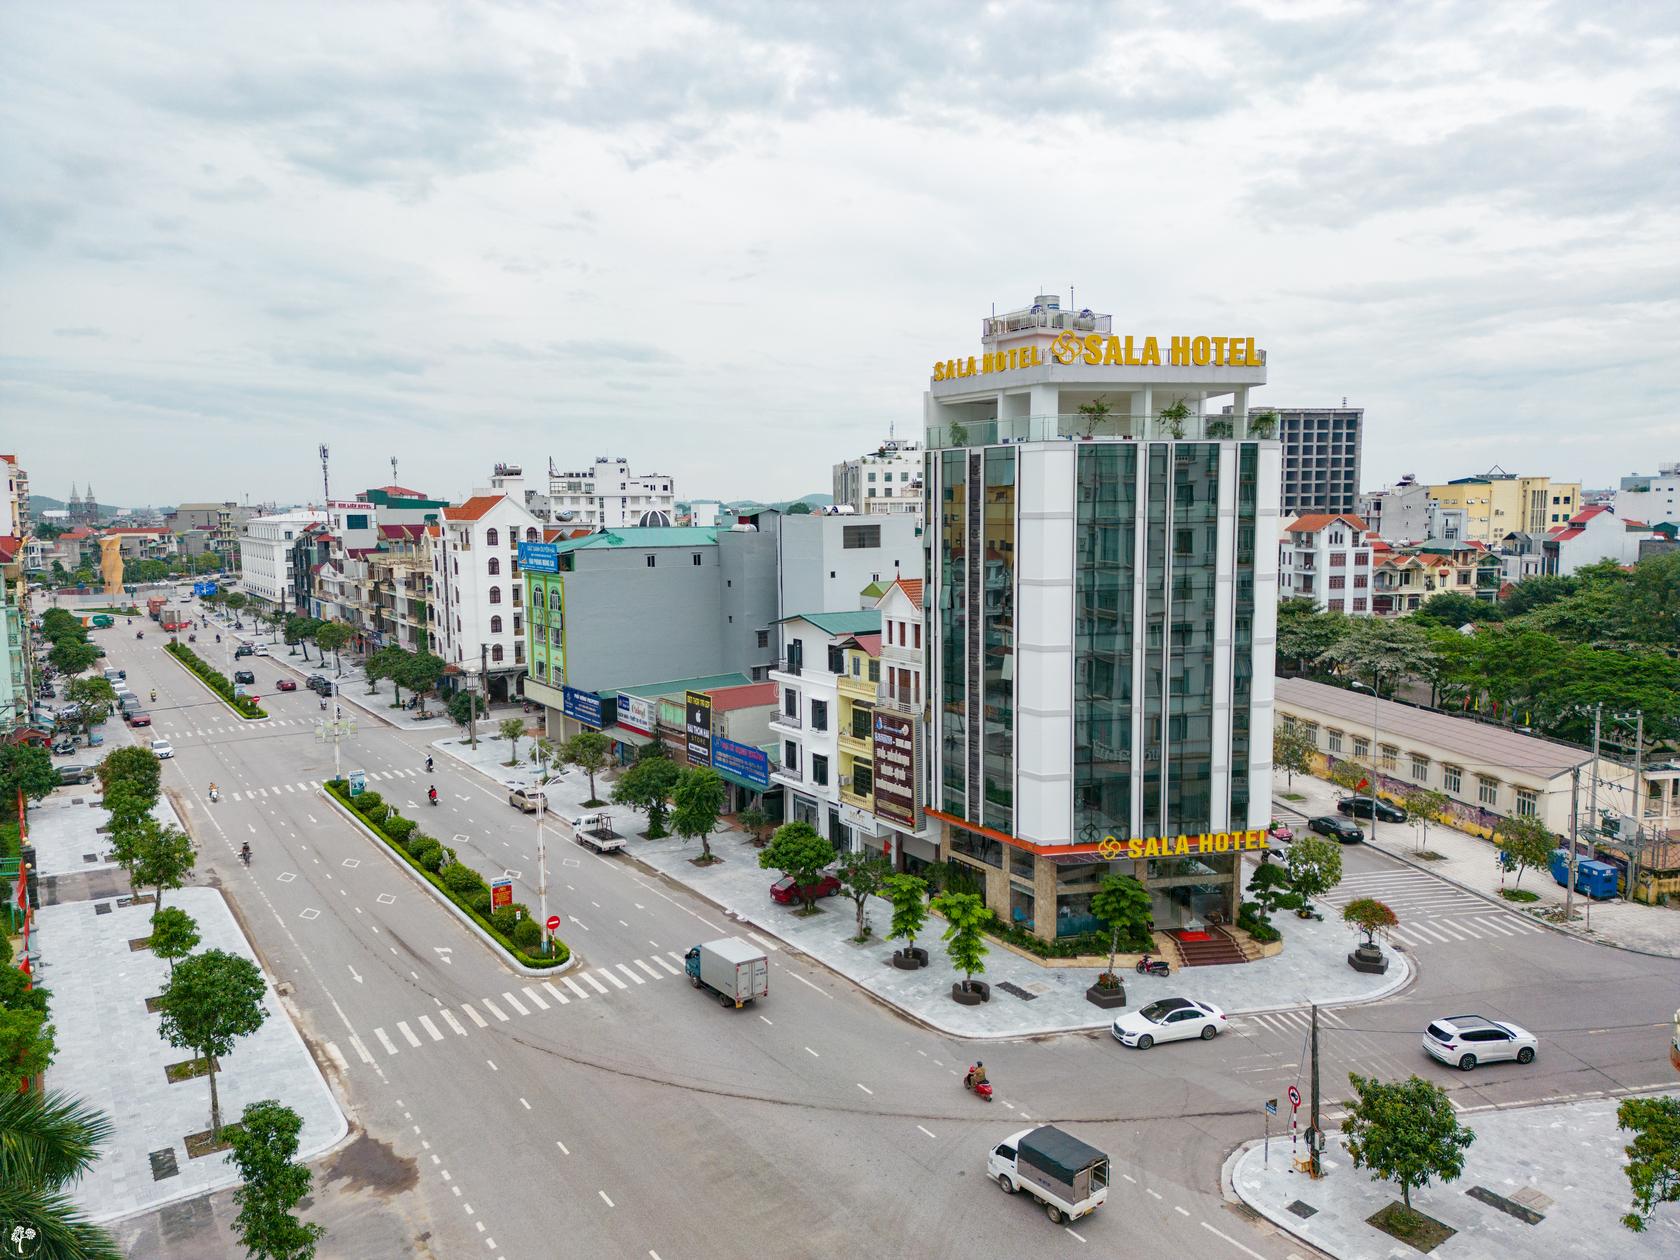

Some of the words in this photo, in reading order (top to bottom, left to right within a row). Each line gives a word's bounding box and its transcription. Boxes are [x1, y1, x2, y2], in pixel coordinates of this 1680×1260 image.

[933, 355, 977, 381] SALA
[982, 345, 1042, 375] HOTEL
[1083, 334, 1161, 366] SALA
[1170, 335, 1262, 367] HOTEL
[691, 735, 706, 746] STORE
[1128, 834, 1190, 859] SALA
[1199, 829, 1270, 854] HOTEL
